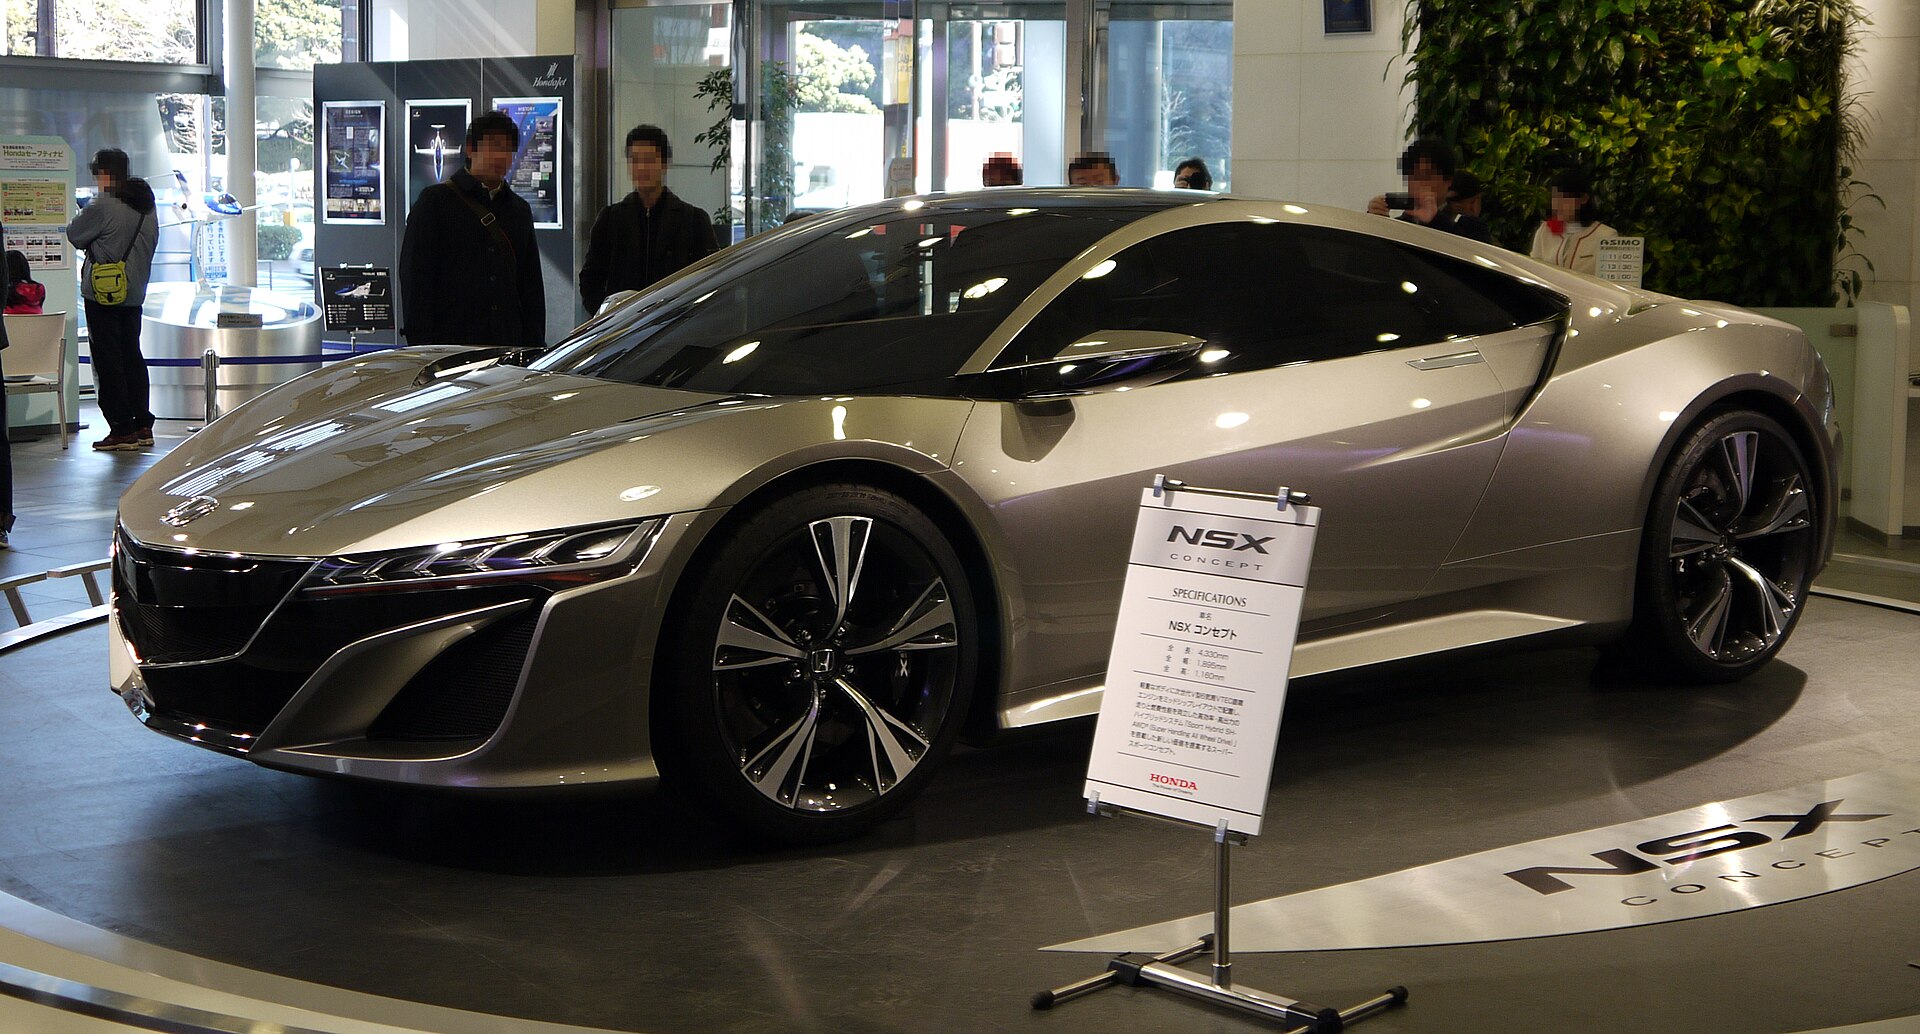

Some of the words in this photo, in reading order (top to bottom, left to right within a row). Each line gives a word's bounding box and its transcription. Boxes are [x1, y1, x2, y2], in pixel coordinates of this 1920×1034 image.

[532, 77, 567, 90] HondaJet
[3, 149, 64, 158] Hondaセーフティナビ
[1167, 525, 1276, 555] NSX
[1170, 553, 1263, 571] CONCEPT
[1172, 587, 1247, 607] SPECIFICATIONS
[1199, 611, 1213, 621] 車名
[1168, 620, 1191, 633] NSX
[1194, 624, 1237, 641] コンセプト
[1198, 649, 1229, 660] 4,330mm
[1197, 659, 1227, 670] 1,895mm
[1195, 669, 1225, 680] 1,160mm
[1150, 773, 1198, 791] HONDA
[1504, 798, 1894, 896] NSX
